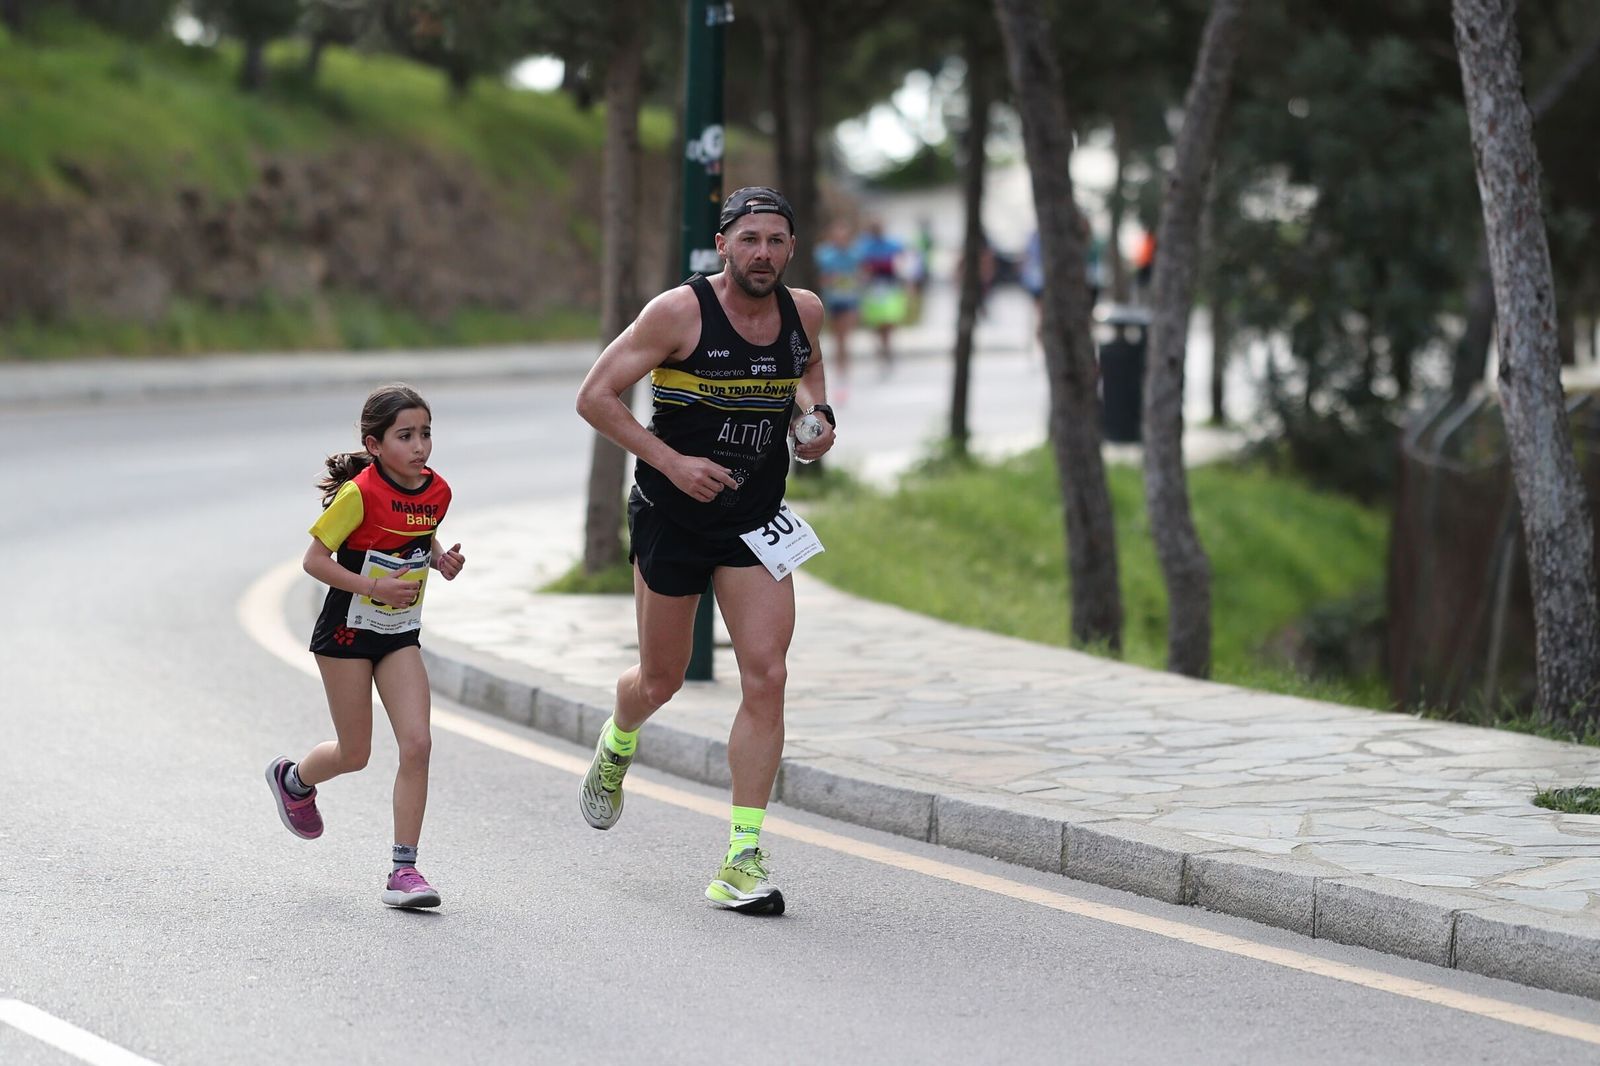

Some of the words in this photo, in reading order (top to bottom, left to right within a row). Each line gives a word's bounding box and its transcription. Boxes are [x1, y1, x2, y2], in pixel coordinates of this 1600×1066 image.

[707, 349, 730, 358] vive
[700, 367, 746, 379] copicentro
[750, 364, 777, 376] gross
[699, 383, 726, 396] CLUB
[727, 381, 779, 395] TRIATLÓN
[391, 501, 439, 517] Málaga
[406, 513, 438, 526] Bahía
